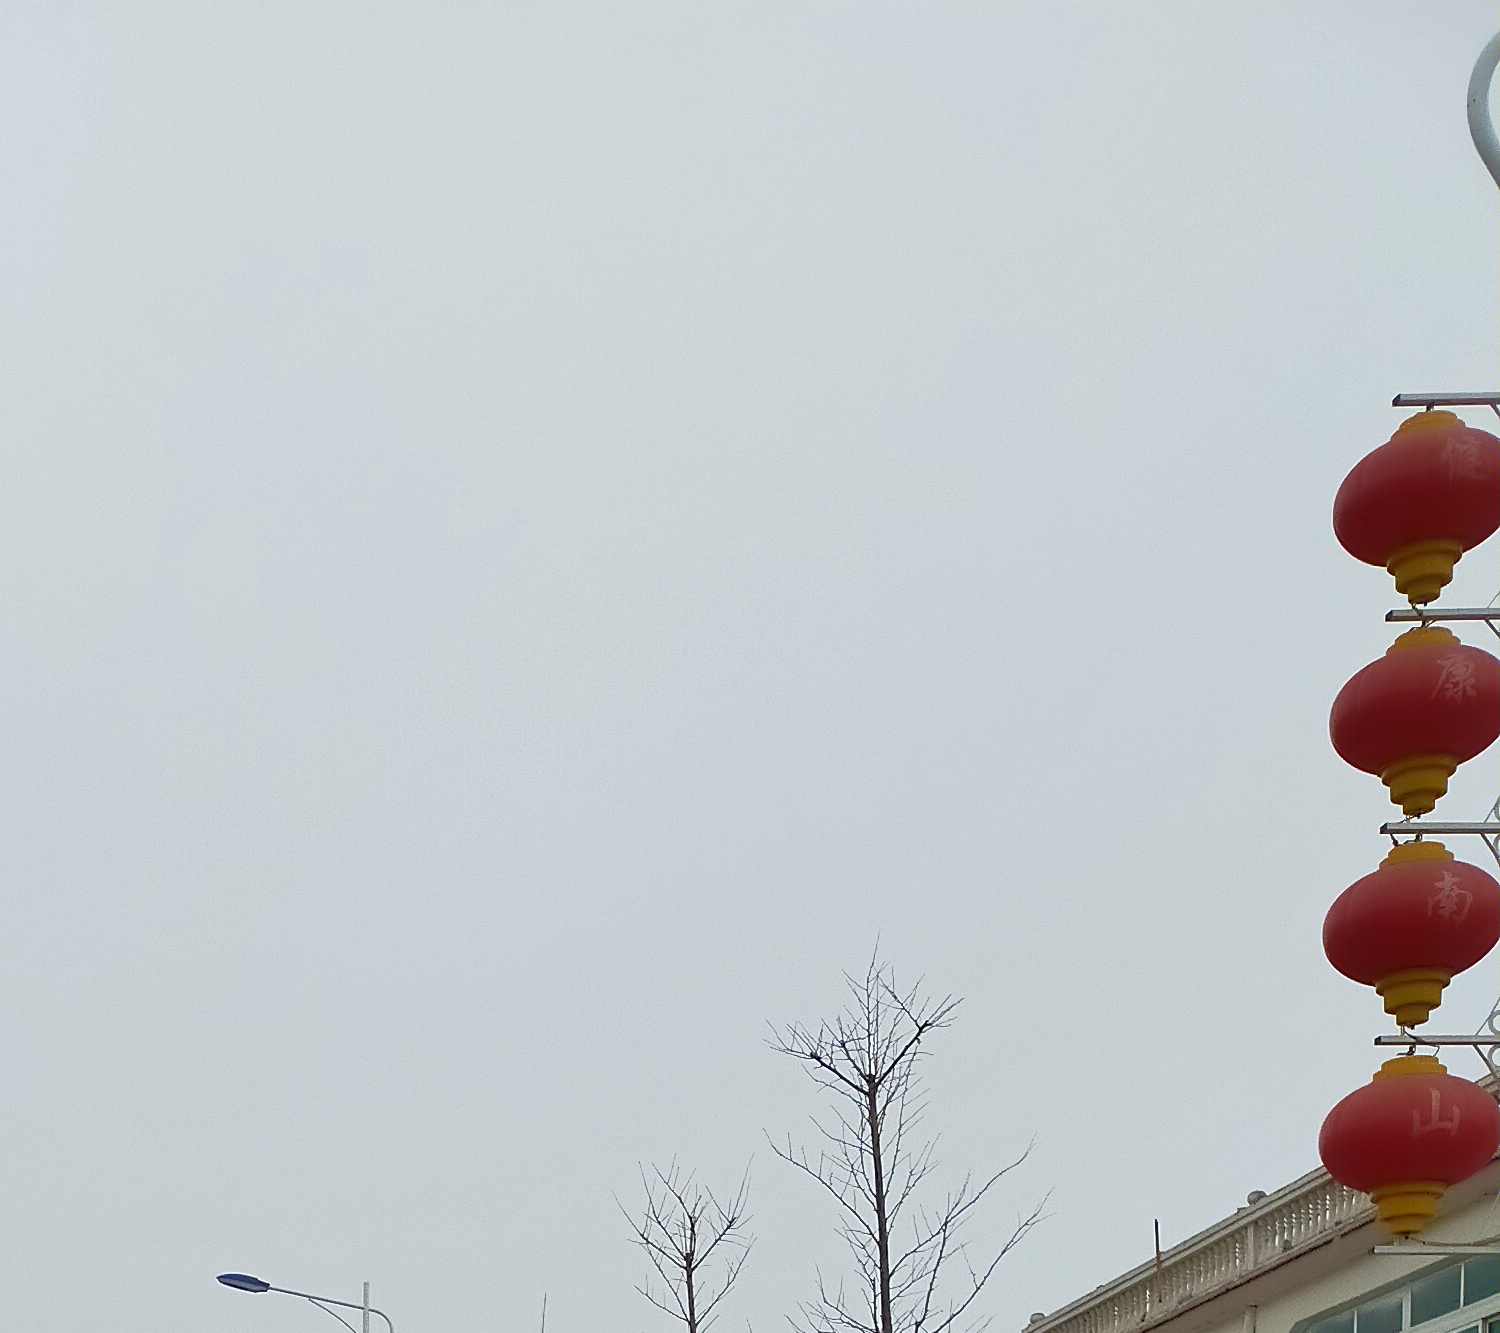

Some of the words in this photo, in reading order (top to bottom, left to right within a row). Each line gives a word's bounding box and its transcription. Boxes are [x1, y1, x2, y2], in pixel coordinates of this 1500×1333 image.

[1431, 656, 1477, 702] 康
[1427, 870, 1473, 924] 南
[1411, 1087, 1461, 1138] 山
